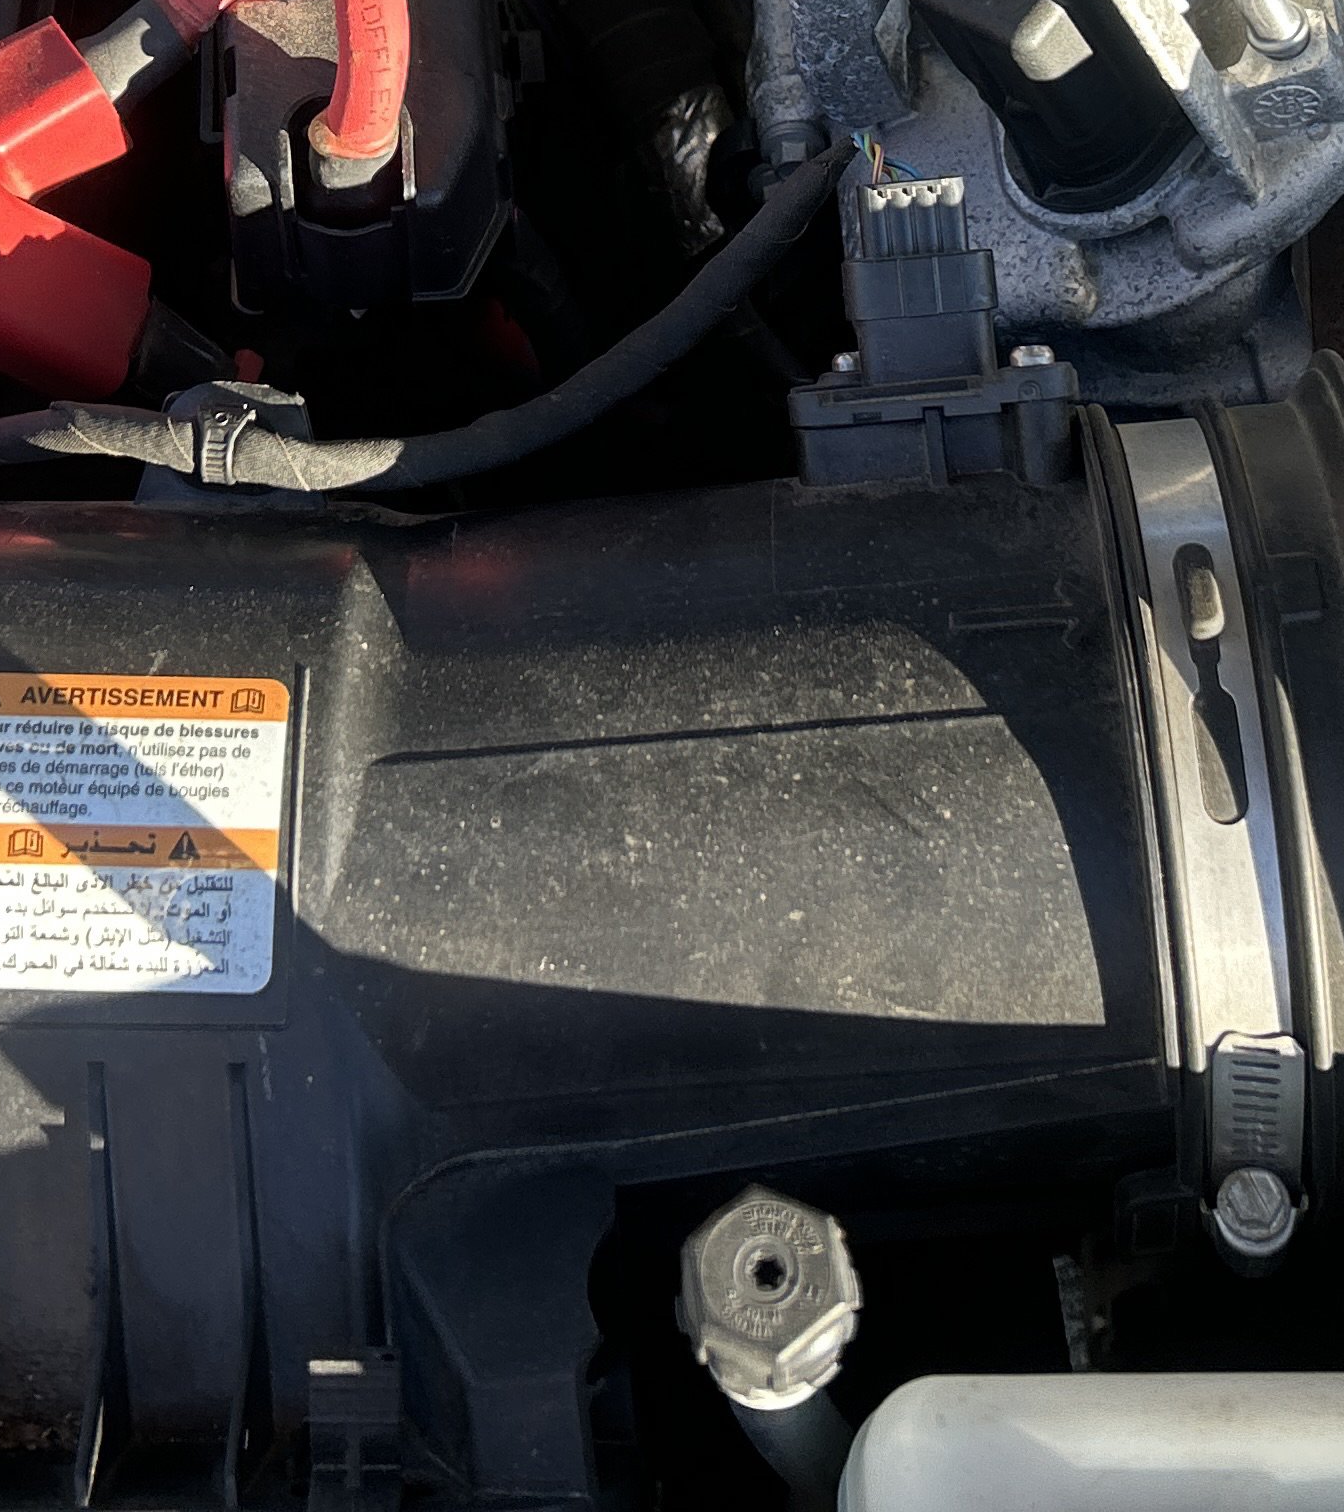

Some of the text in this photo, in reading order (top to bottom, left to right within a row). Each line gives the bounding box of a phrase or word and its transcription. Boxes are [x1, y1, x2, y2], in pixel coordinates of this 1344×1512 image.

[20, 683, 225, 710] AVERTISSEMENT
[14, 717, 75, 735] réduire
[78, 720, 94, 735] le
[96, 720, 150, 740] risque
[153, 722, 175, 737] de
[178, 722, 260, 740] blessures
[126, 740, 195, 760] n'utilisez
[198, 745, 227, 761] pas
[230, 744, 252, 758] de
[20, 759, 41, 773] de
[44, 758, 130, 778] démarrage
[170, 761, 225, 779] l'éther)
[4, 781, 24, 794] ce
[27, 780, 83, 795] moteur
[86, 779, 140, 800] équipé
[144, 782, 165, 796] de
[168, 783, 231, 802] bougies
[63, 955, 84, 975] في
